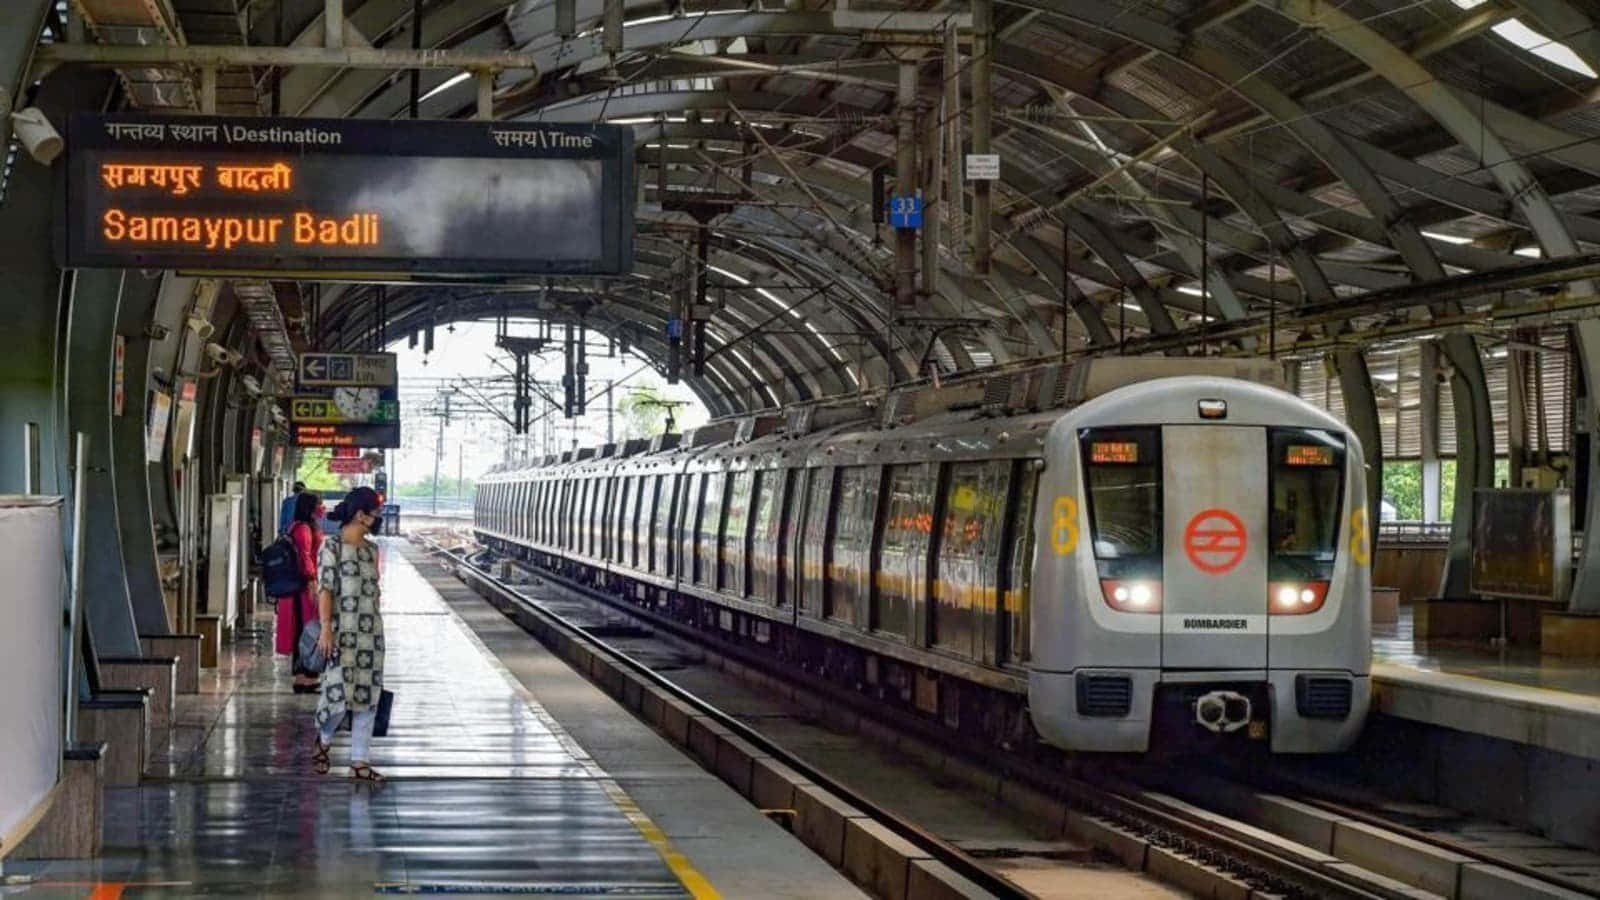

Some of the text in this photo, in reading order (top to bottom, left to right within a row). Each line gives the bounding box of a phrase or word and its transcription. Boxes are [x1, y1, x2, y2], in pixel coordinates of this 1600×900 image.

[105, 122, 165, 140] गन्तव्य
[168, 124, 218, 142] स्थान
[102, 162, 292, 194] समयपुर बादली
[896, 197, 914, 214] 33
[104, 209, 379, 249] Samaypur Badli
[1051, 496, 1079, 555] 8
[1183, 618, 1248, 629] BOMBARDIER
